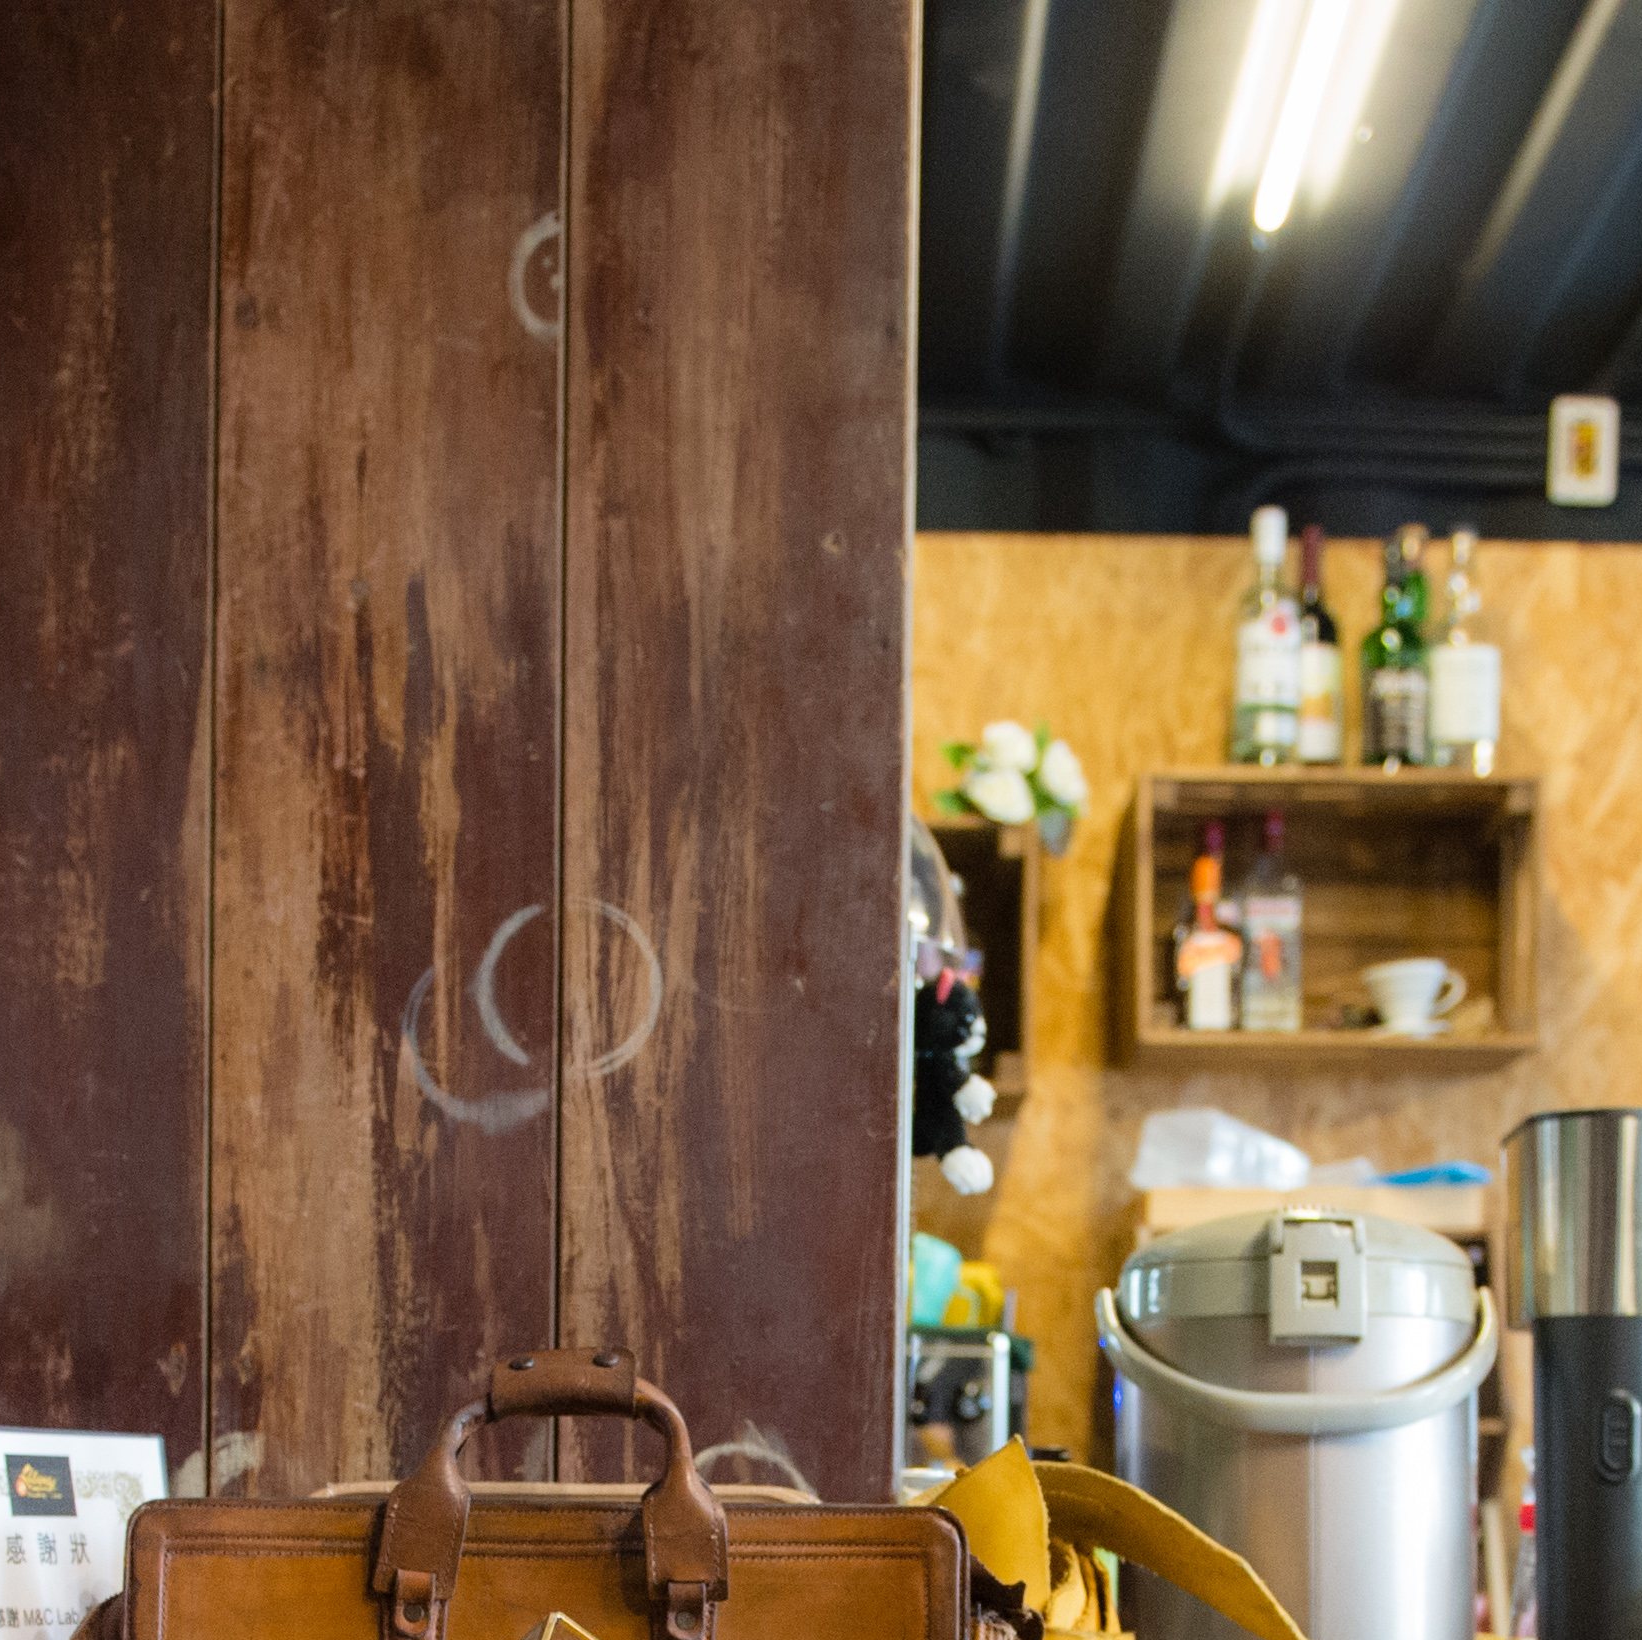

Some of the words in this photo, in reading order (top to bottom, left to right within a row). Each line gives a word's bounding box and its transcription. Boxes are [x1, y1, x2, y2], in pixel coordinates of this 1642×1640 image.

[5, 1532, 91, 1566] 感謝狀
[22, 1607, 54, 1627] M&C
[57, 1607, 80, 1627] Lab
